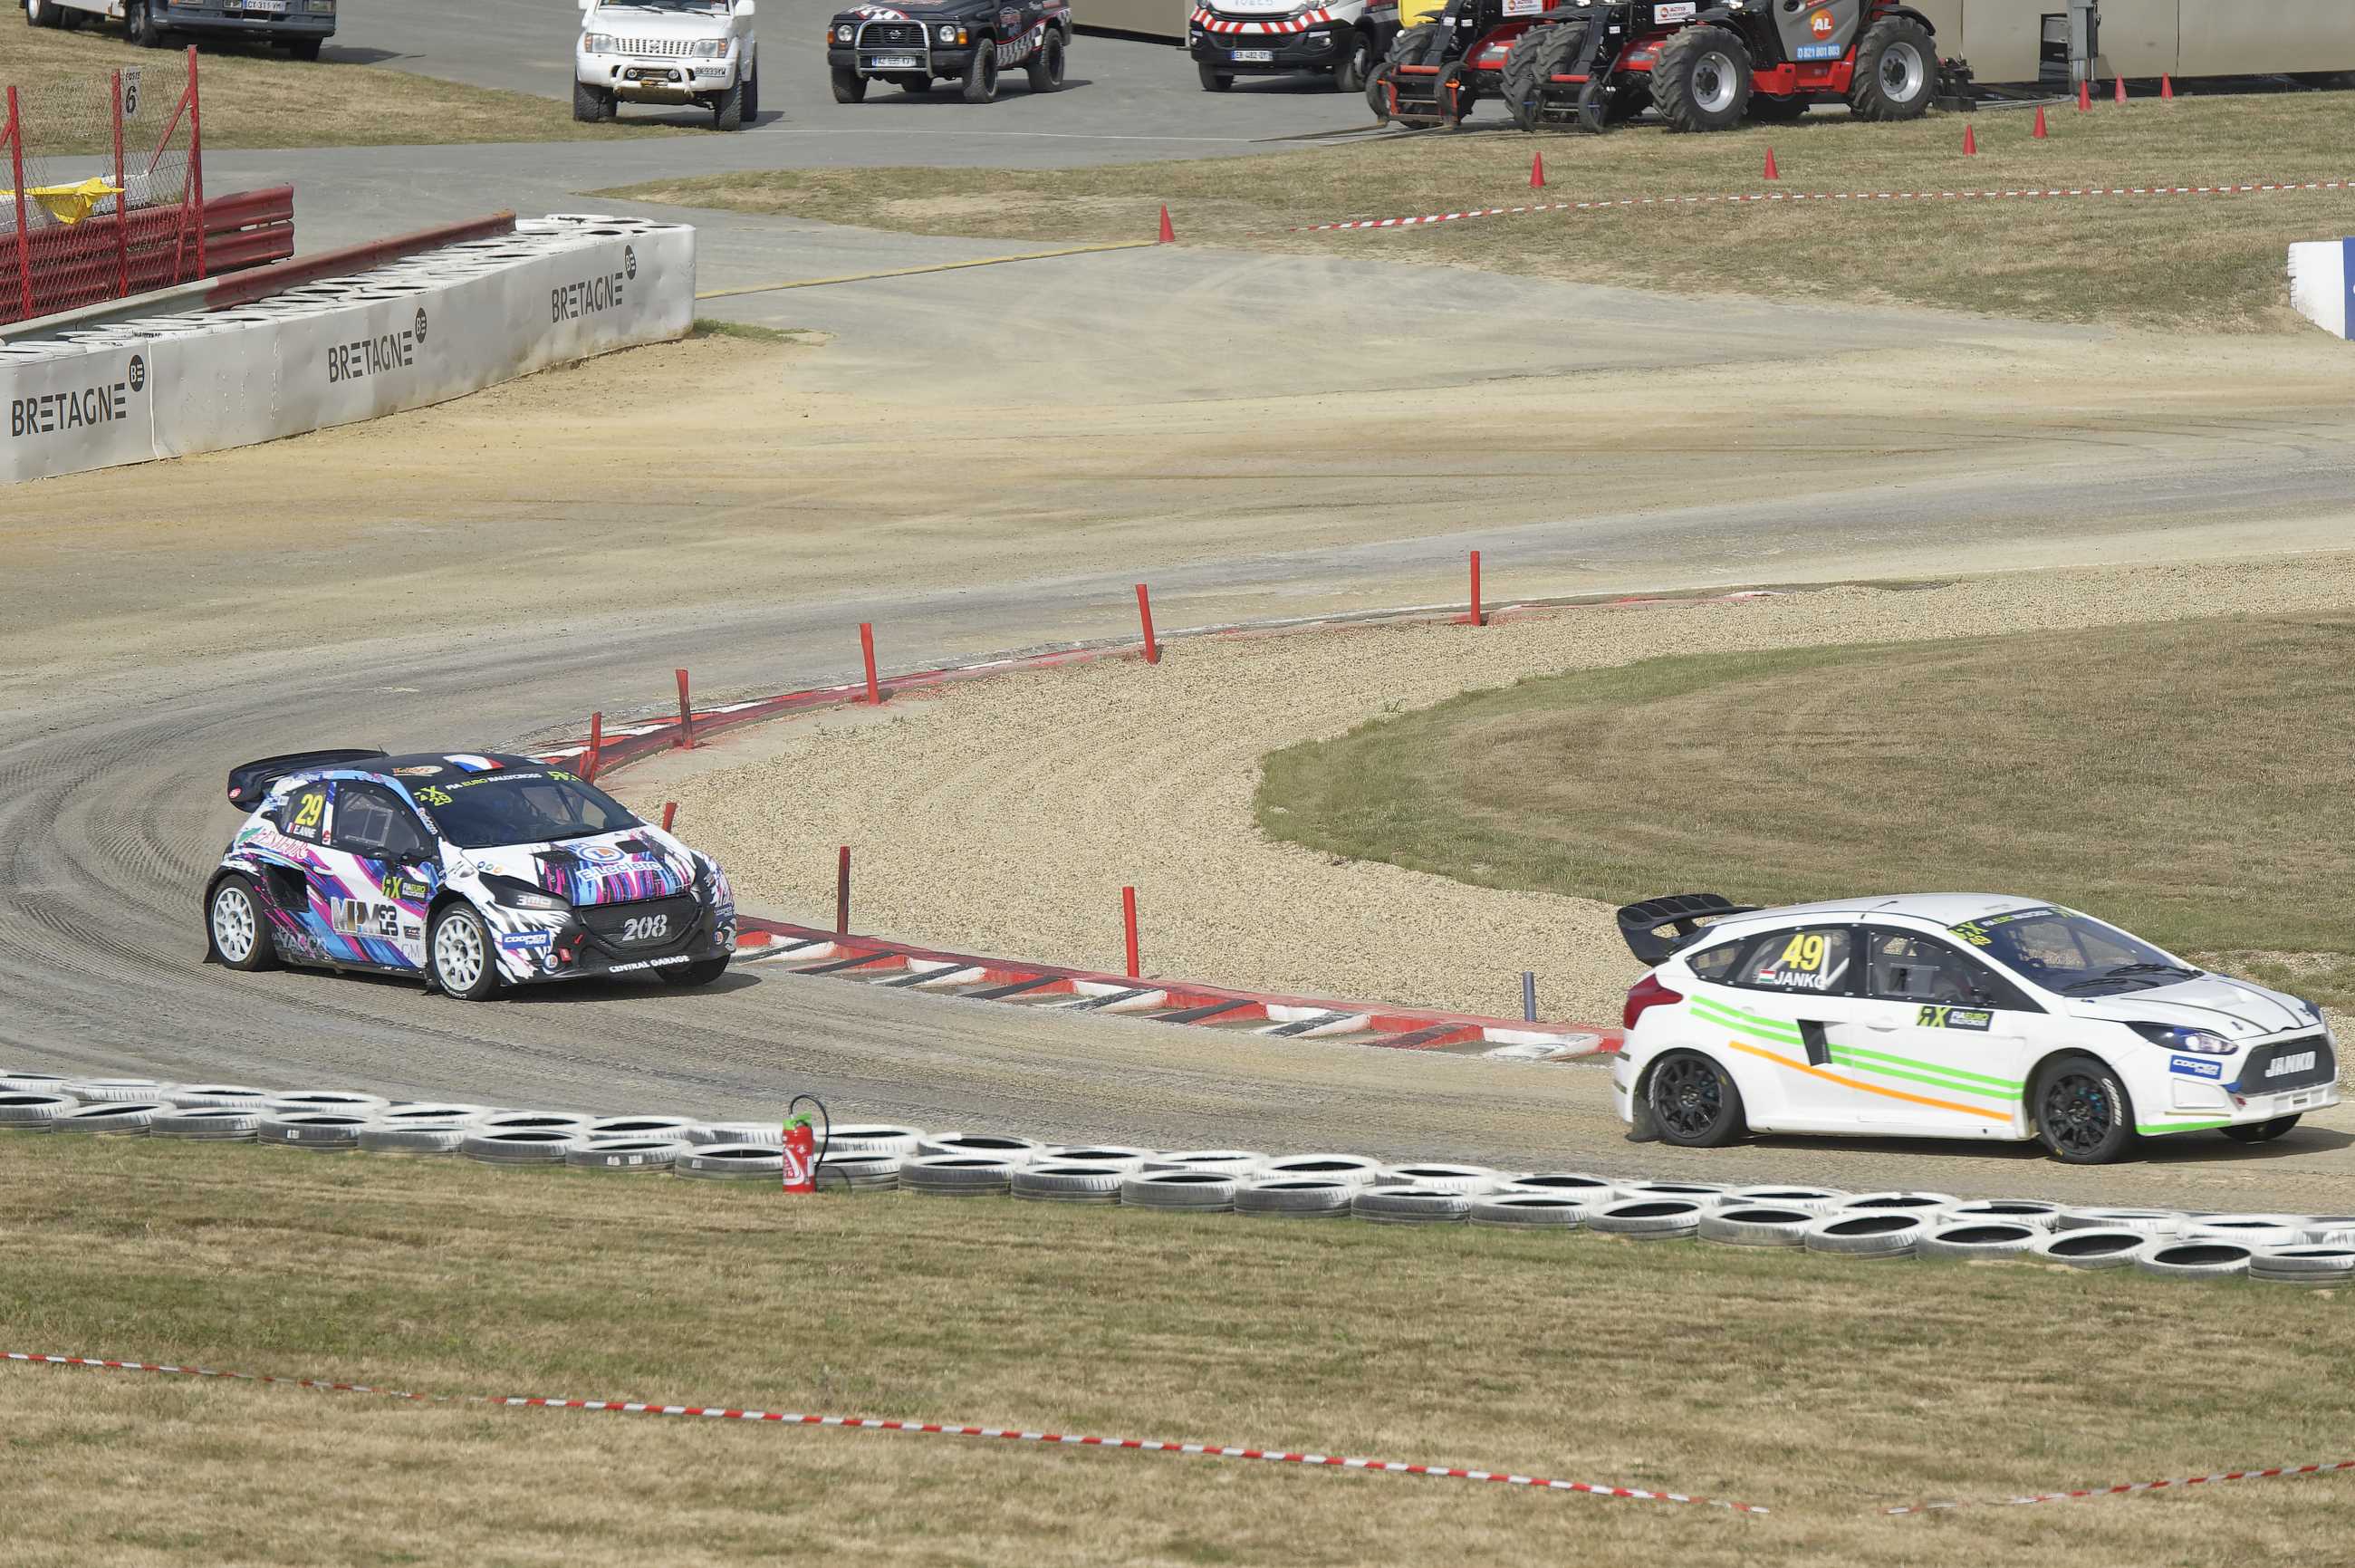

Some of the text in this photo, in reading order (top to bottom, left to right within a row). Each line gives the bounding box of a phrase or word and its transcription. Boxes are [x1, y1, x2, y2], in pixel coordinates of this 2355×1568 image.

[1813, 18, 1831, 31] AL
[126, 85, 137, 114] 6
[551, 272, 623, 323] BRETAGNE
[328, 331, 413, 383] BRETAGNE
[12, 382, 127, 437] BRETAGNE
[462, 778, 488, 787] EURO
[294, 794, 323, 826] 29
[429, 794, 452, 806] 29
[505, 934, 547, 943] COOPER
[622, 914, 667, 941] 208
[1782, 934, 1824, 971] 49
[1969, 935, 1993, 947] 49
[608, 955, 690, 973] CENTRAL GARAGE
[1773, 970, 1827, 991] JANKO
[2172, 1059, 2219, 1071] COOPER
[2265, 1051, 2316, 1078] JANKO
